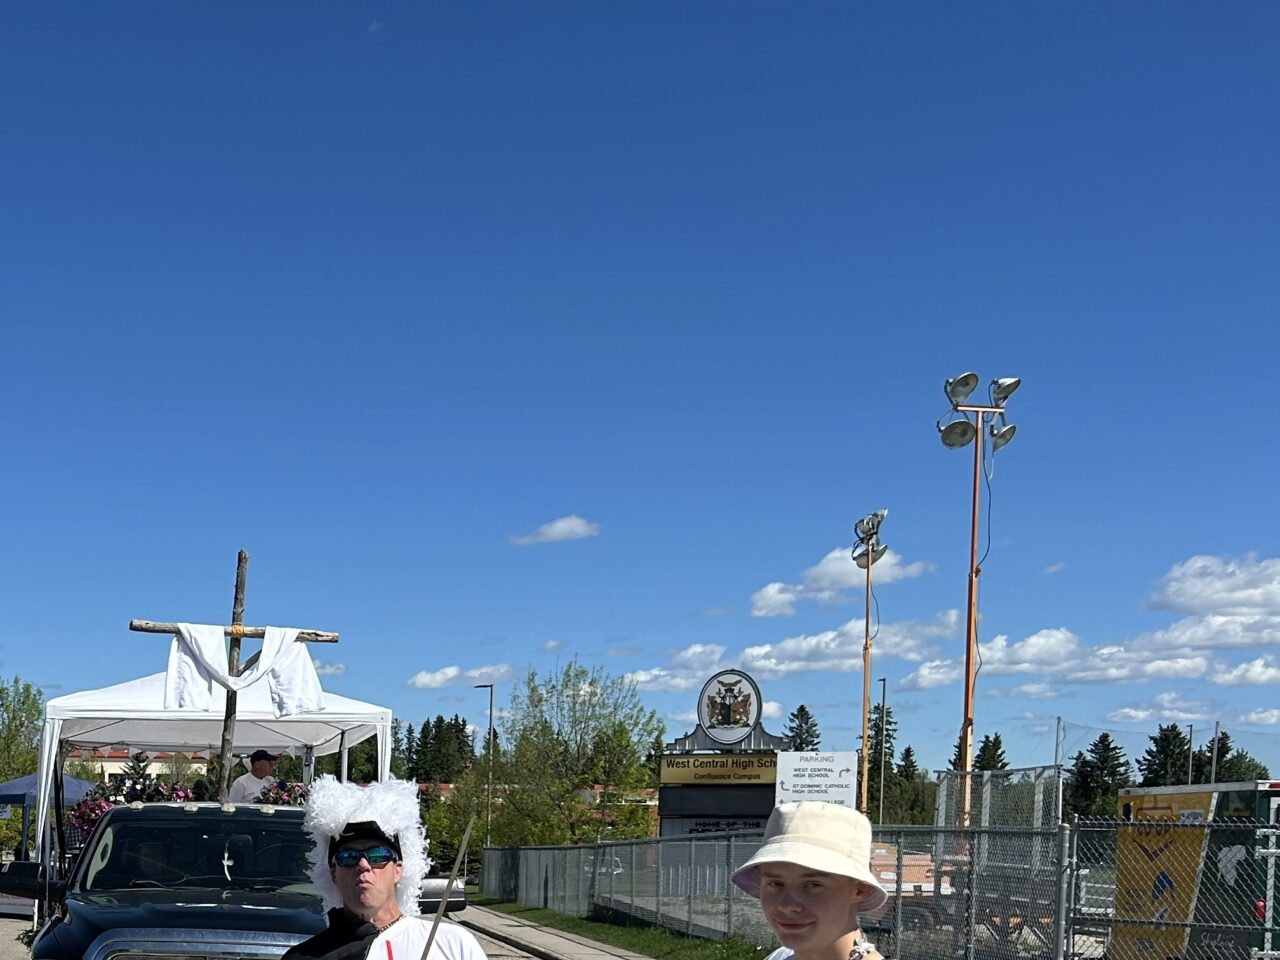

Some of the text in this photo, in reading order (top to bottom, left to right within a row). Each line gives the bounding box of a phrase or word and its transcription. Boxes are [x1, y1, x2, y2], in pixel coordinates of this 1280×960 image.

[666, 759, 777, 770] West Central High Sch
[733, 773, 761, 781] Campus
